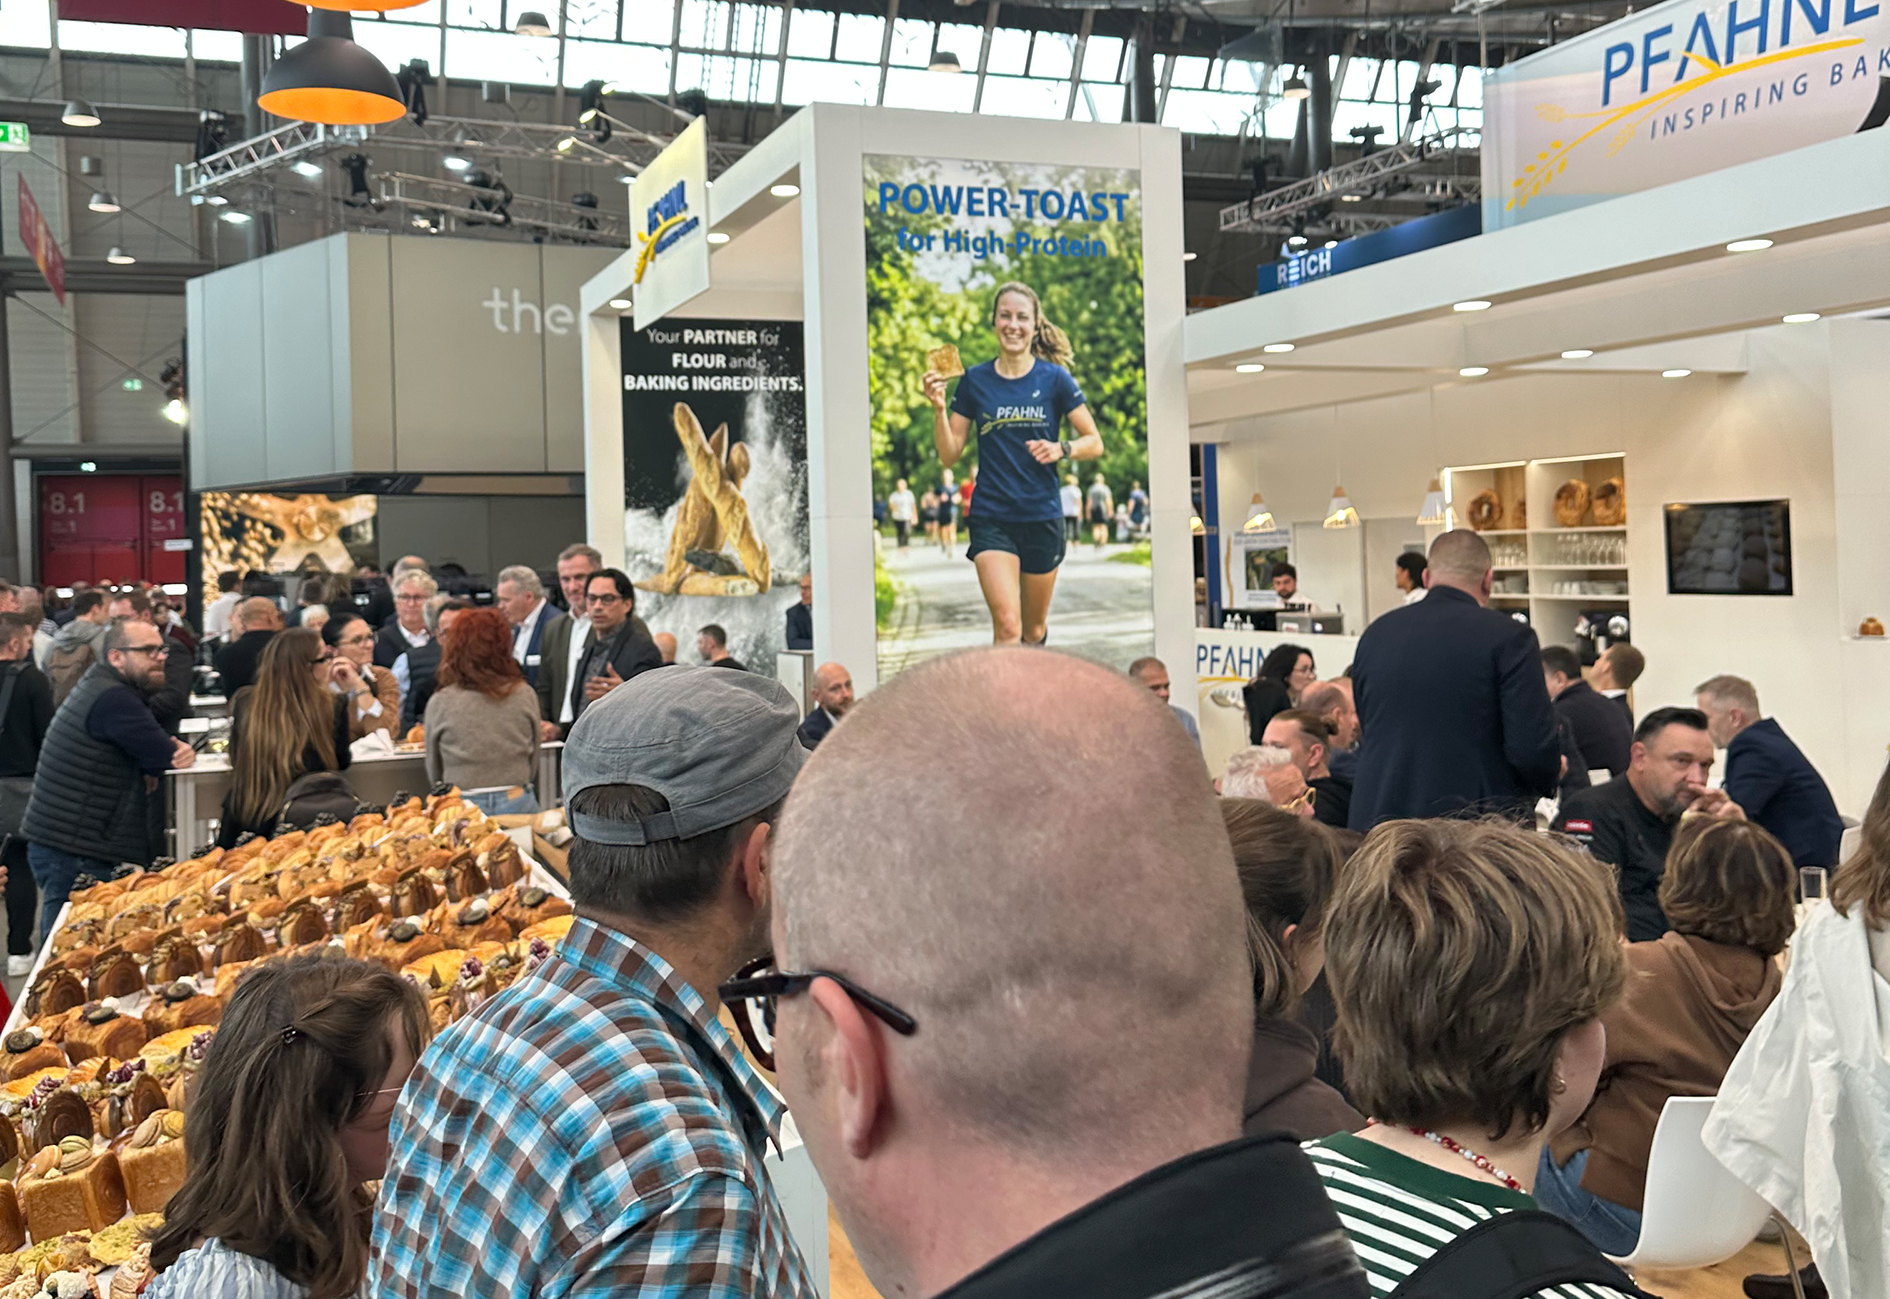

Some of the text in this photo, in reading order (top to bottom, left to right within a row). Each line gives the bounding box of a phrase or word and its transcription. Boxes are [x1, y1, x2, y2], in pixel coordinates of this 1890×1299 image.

[1650, 73, 1809, 139] INSPIRING
[879, 182, 1130, 222] POWER-TOAST
[898, 226, 1107, 260] for High-Protein
[1277, 250, 1332, 285] REICH
[482, 287, 582, 335] the
[647, 328, 780, 346] Your PARTNER for
[671, 351, 757, 369] FLOUR and
[624, 374, 804, 392] BAKING INGREDIENTS.
[997, 406, 1046, 418] PFAHNL
[50, 491, 86, 515] 8.1
[150, 490, 185, 513] 8.1
[168, 518, 176, 531] 1
